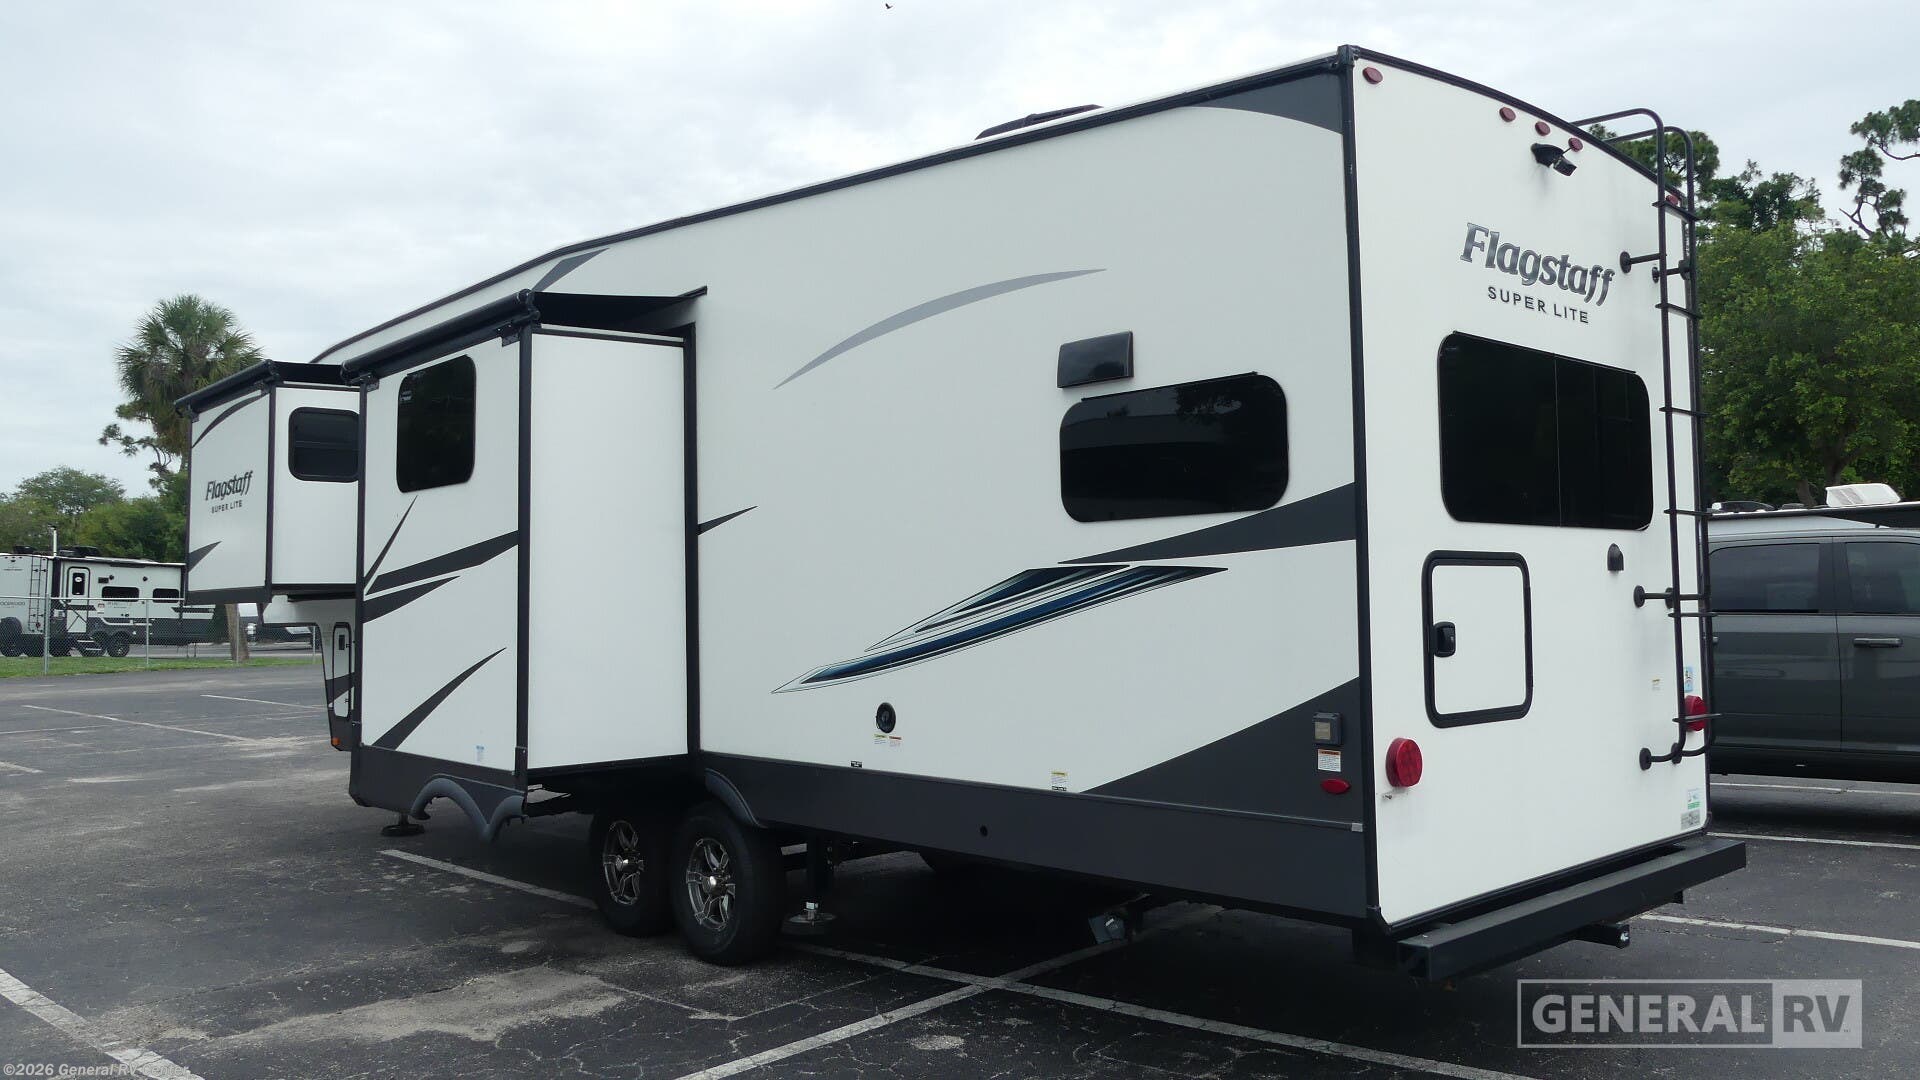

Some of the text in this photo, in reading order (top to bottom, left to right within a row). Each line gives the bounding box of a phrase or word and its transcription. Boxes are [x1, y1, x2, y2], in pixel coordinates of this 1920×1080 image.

[1460, 222, 1615, 306] Flagstaff
[1487, 286, 1589, 324] SUPER LITE
[205, 470, 253, 501] Flagstaff
[211, 500, 242, 514] SUPER LITE
